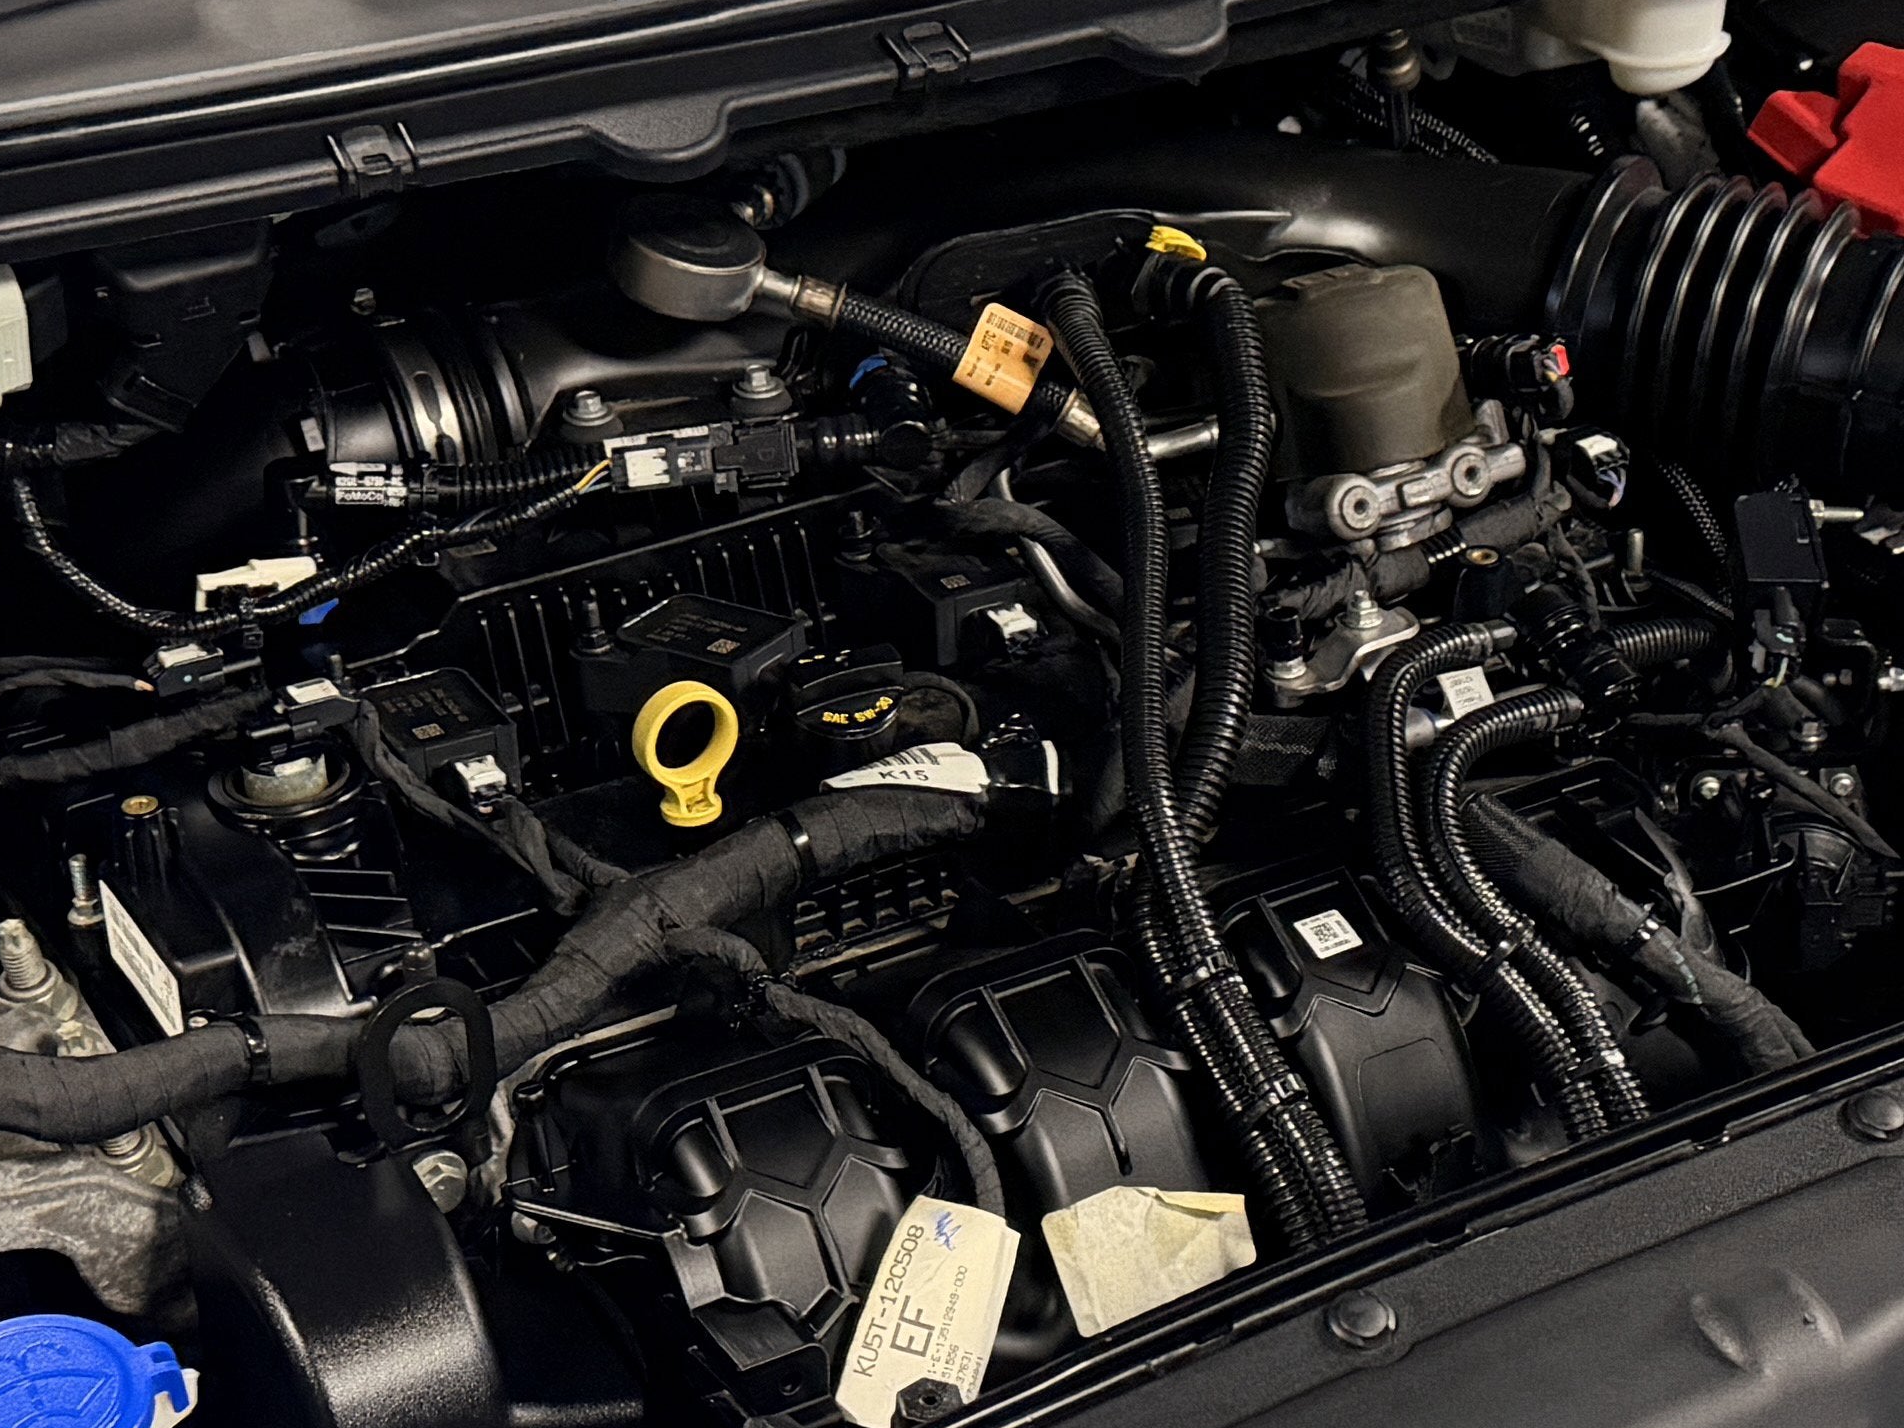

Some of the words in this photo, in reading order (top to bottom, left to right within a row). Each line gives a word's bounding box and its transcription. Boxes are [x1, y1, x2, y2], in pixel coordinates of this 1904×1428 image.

[337, 490, 384, 501] FoMoCo
[822, 711, 849, 724] SAE
[878, 769, 931, 782] K15
[853, 1224, 925, 1378] KU5T-12C508
[889, 1295, 936, 1358] EF
